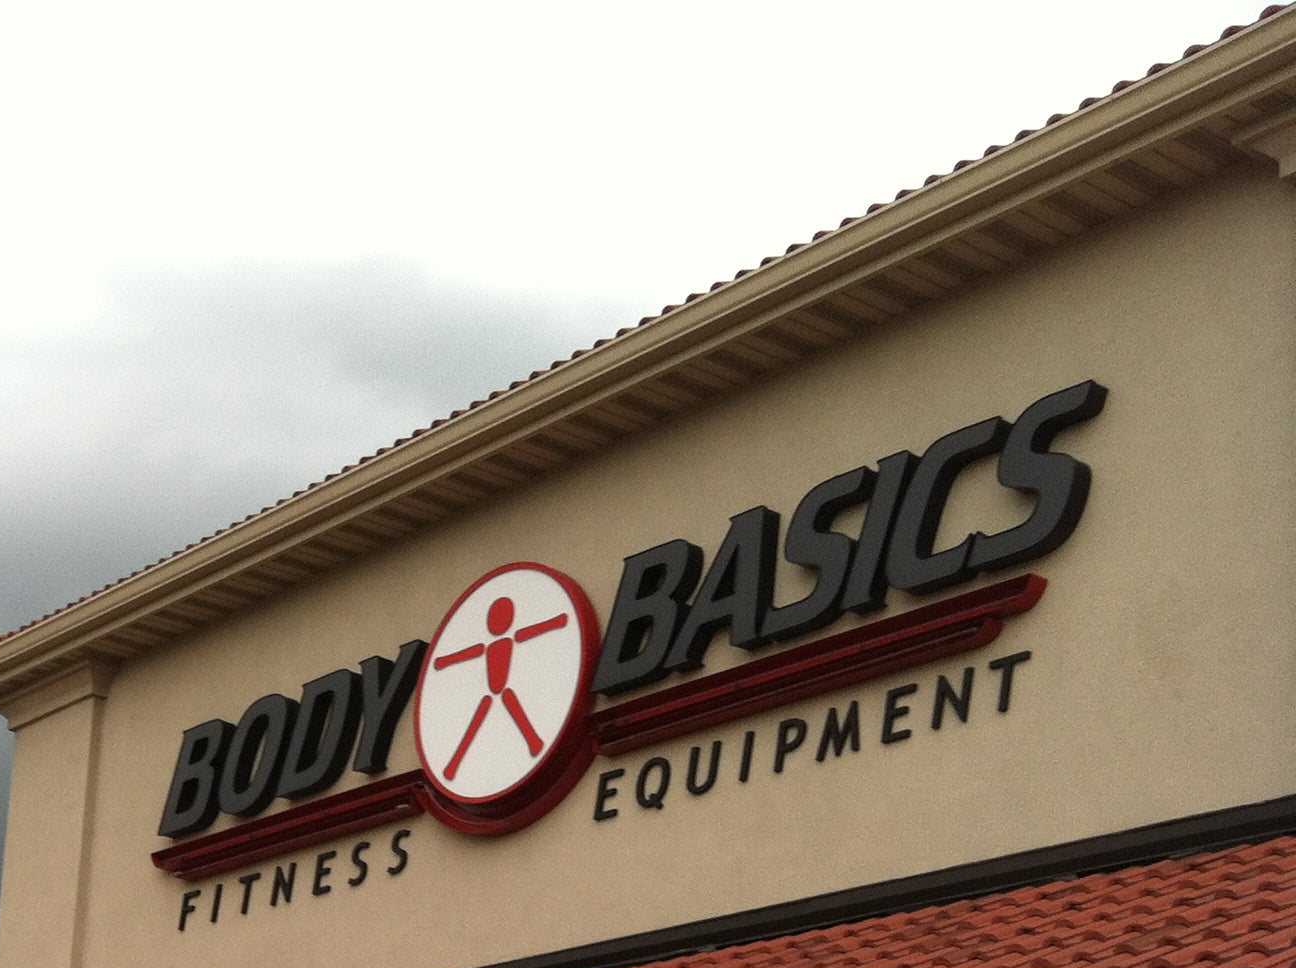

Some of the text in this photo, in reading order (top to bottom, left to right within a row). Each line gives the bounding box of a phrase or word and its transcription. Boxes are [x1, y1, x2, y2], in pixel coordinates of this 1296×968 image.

[158, 378, 1108, 839] BODY BASICS
[178, 650, 1031, 932] FITNESS EQUIPMENT
